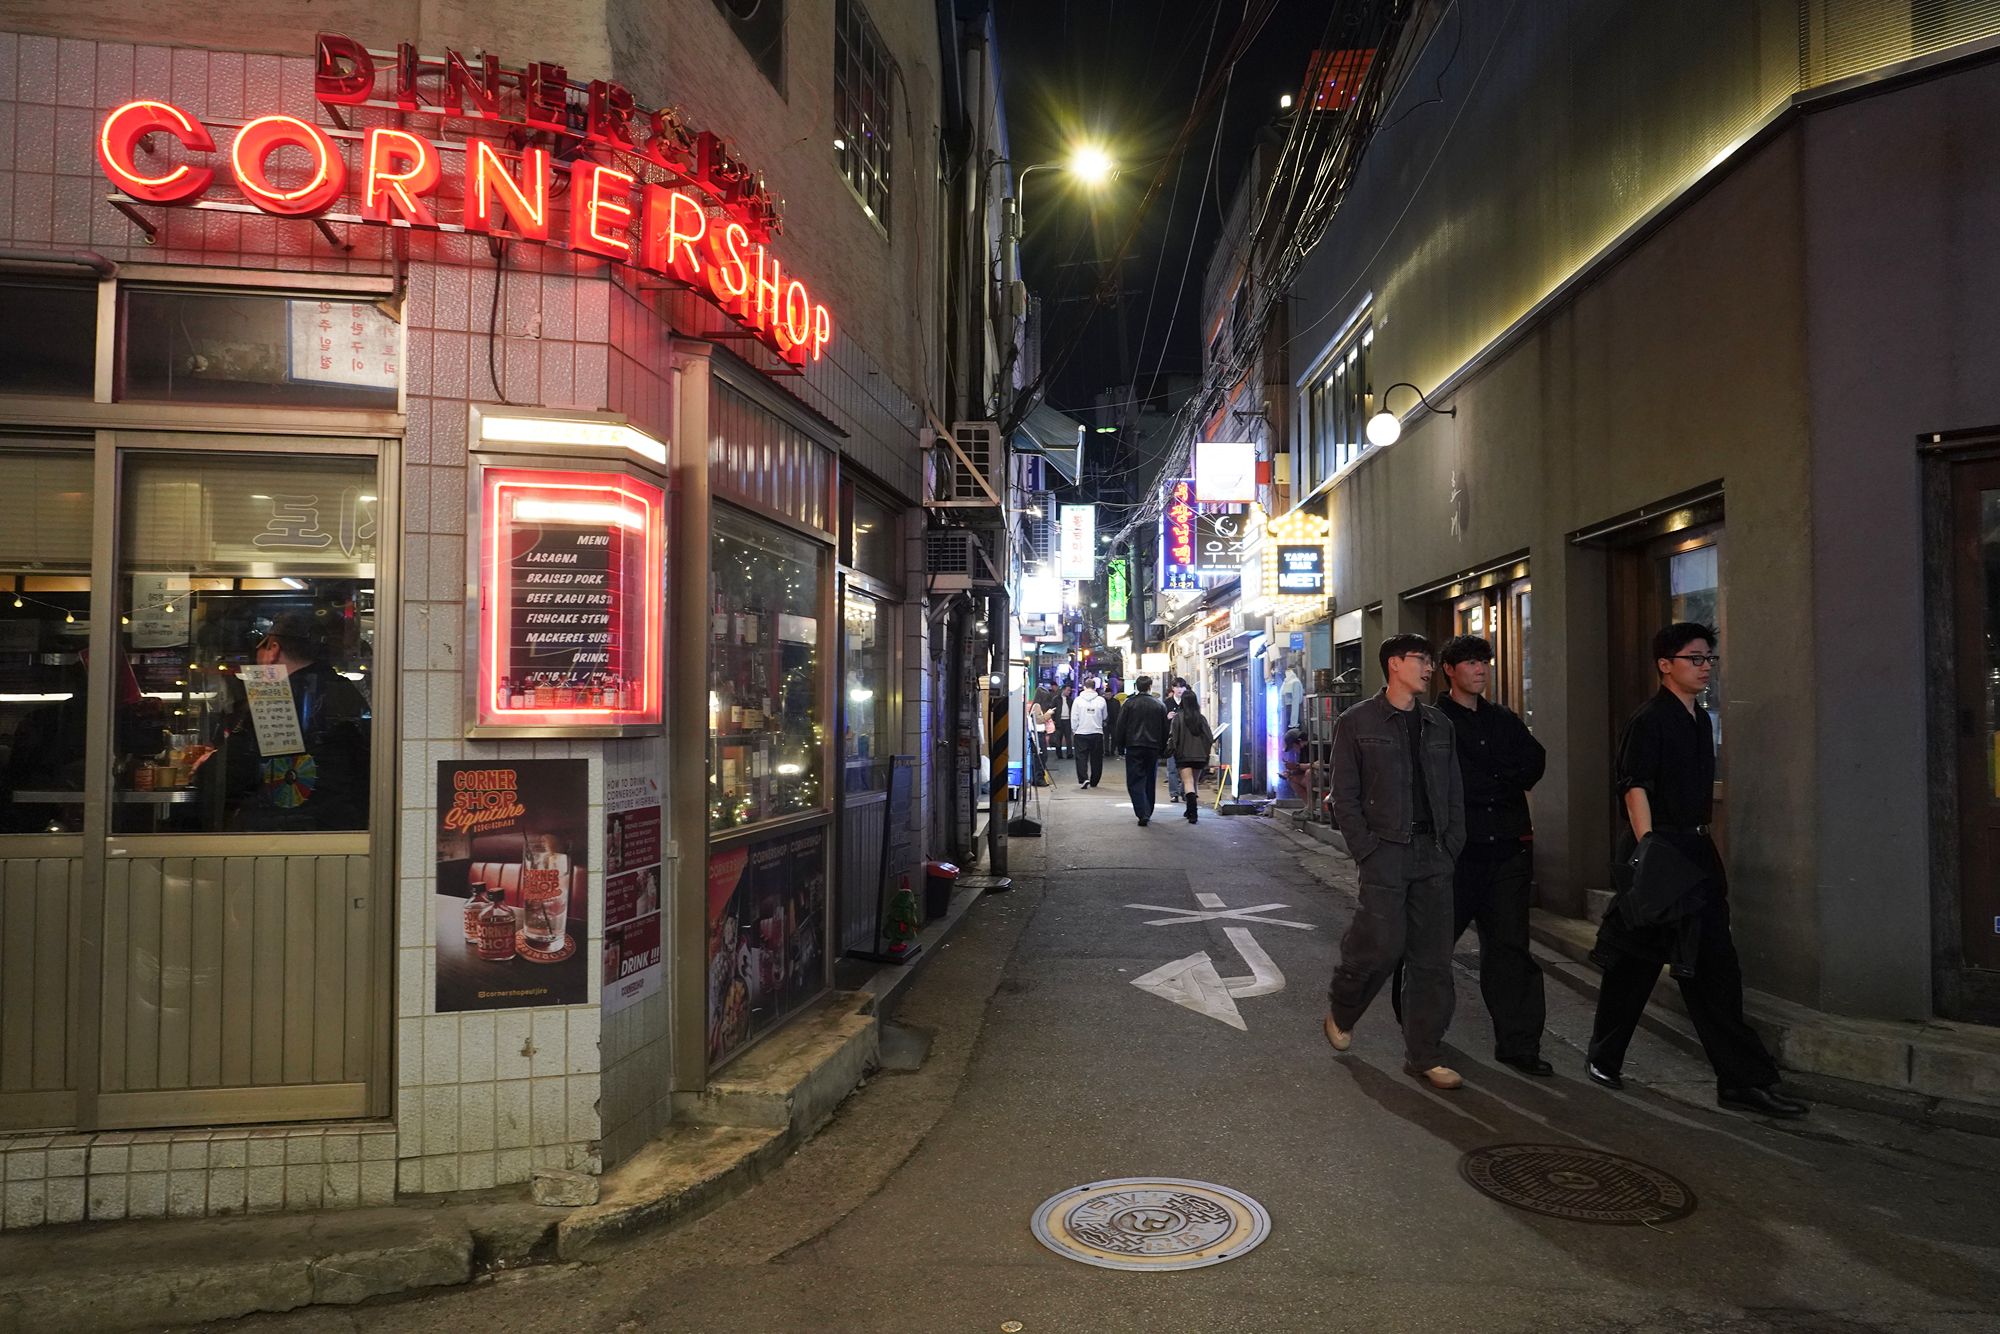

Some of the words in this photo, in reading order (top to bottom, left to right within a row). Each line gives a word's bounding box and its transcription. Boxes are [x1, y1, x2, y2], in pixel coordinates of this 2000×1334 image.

[315, 33, 637, 150] DINER
[101, 99, 832, 365] CORNERSHOP
[577, 535, 609, 546] MENU
[526, 552, 578, 563] LASAGNA
[1284, 553, 1318, 562] TAPAS
[1290, 561, 1313, 570] BAR
[526, 573, 573, 584] BRAISED
[574, 574, 604, 585] PORK
[1279, 573, 1323, 588] MEET
[526, 593, 553, 604] BEEF
[554, 594, 586, 604] RAGU
[526, 613, 579, 624] FISHCAKE
[580, 614, 609, 624] STEW
[525, 632, 584, 643] MACKEREL
[454, 770, 517, 790] CORNER
[454, 791, 517, 809] SHOP
[621, 951, 650, 977] DRINK
